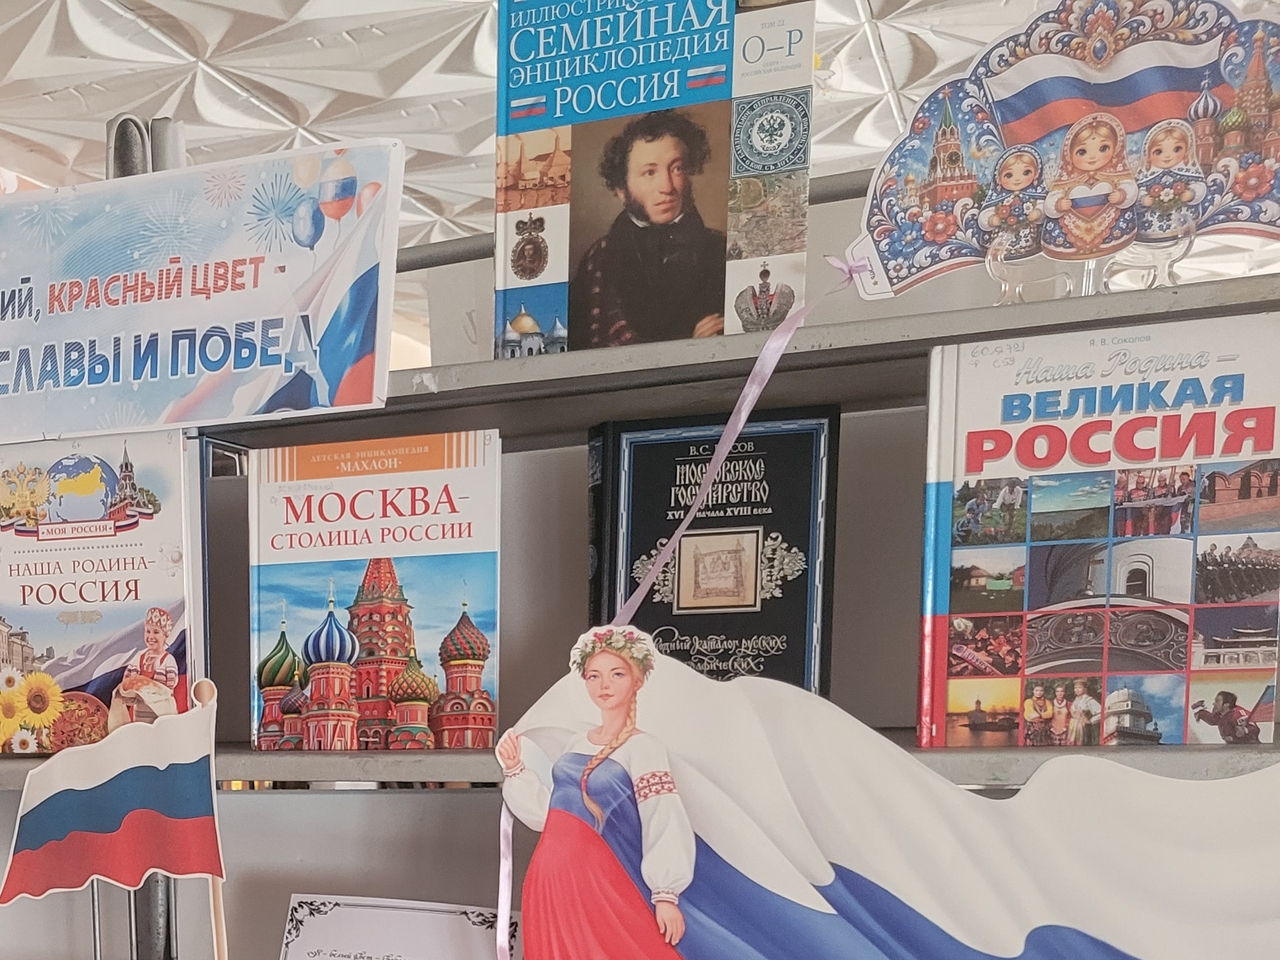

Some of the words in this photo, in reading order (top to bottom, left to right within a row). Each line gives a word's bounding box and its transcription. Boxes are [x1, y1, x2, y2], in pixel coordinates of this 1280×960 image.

[509, 0, 731, 63] СЕМЕЙНАЯ
[509, 28, 730, 89] ЭНЦИКЛОПЕДИЯ
[553, 68, 680, 118] РОССИЯ
[47, 256, 184, 316] КРАСНЫЙ
[190, 256, 265, 300] ЦВЕТ
[131, 332, 159, 382] И
[1111, 334, 1152, 346] Соколов
[1014, 357, 1095, 386] Наша
[1100, 348, 1210, 379] Родина
[1000, 373, 1246, 424] ВЕЛИКАЯ
[310, 452, 351, 463] ДЕТСКАЯ
[355, 446, 429, 459] ЭНЦИКЛОПЕДИЯ
[965, 405, 1277, 476] РОССИЯ
[283, 483, 470, 525] МОСКВА-
[46, 526, 67, 536] МОЯ
[71, 524, 108, 535] РОССИЯ
[270, 528, 373, 551] СТОЛИЦА
[379, 522, 474, 544] РОССИИ
[8, 560, 64, 578] НАША
[19, 578, 141, 607] РОССИЯ
